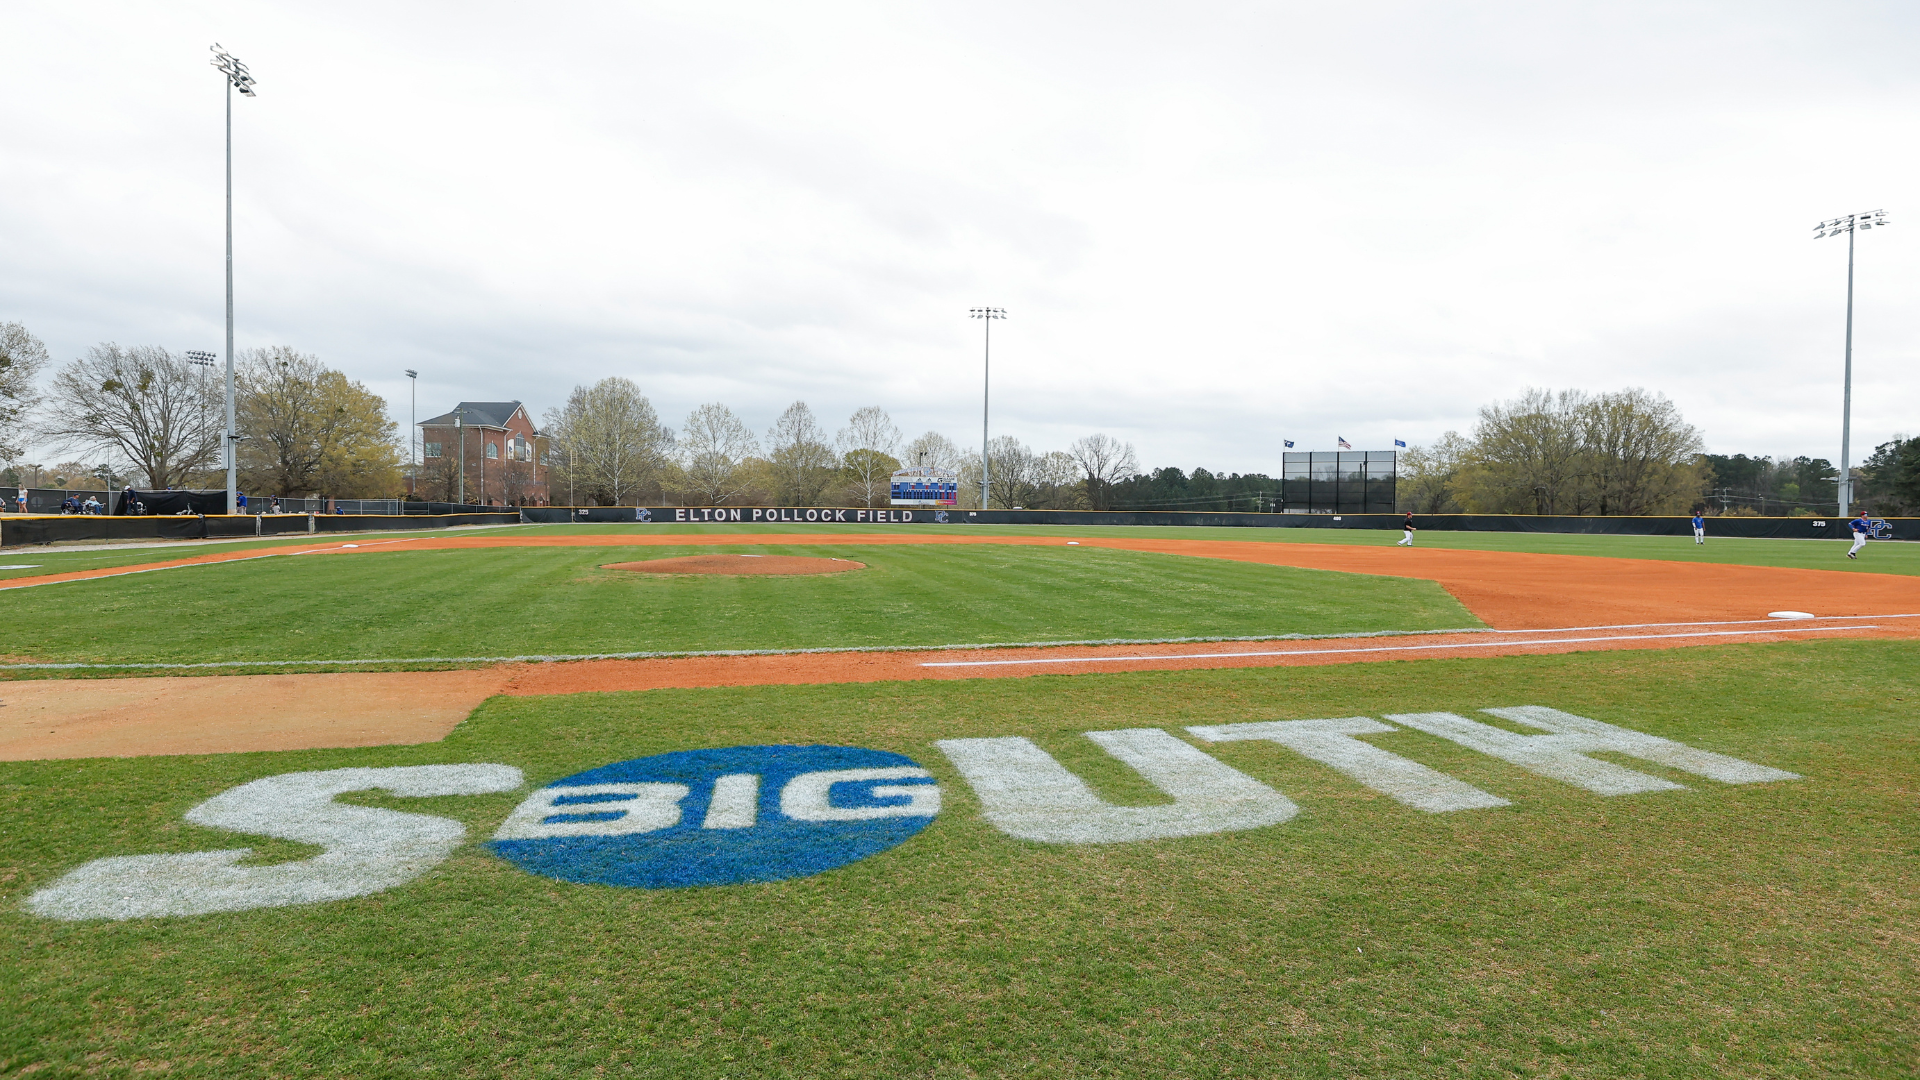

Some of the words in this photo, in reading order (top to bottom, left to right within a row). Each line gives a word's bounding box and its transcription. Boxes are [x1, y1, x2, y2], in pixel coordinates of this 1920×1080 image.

[675, 508, 741, 521] ELTON
[752, 508, 846, 522] POLLOCK
[857, 510, 913, 522] FIELD
[488, 765, 943, 839] BIG
